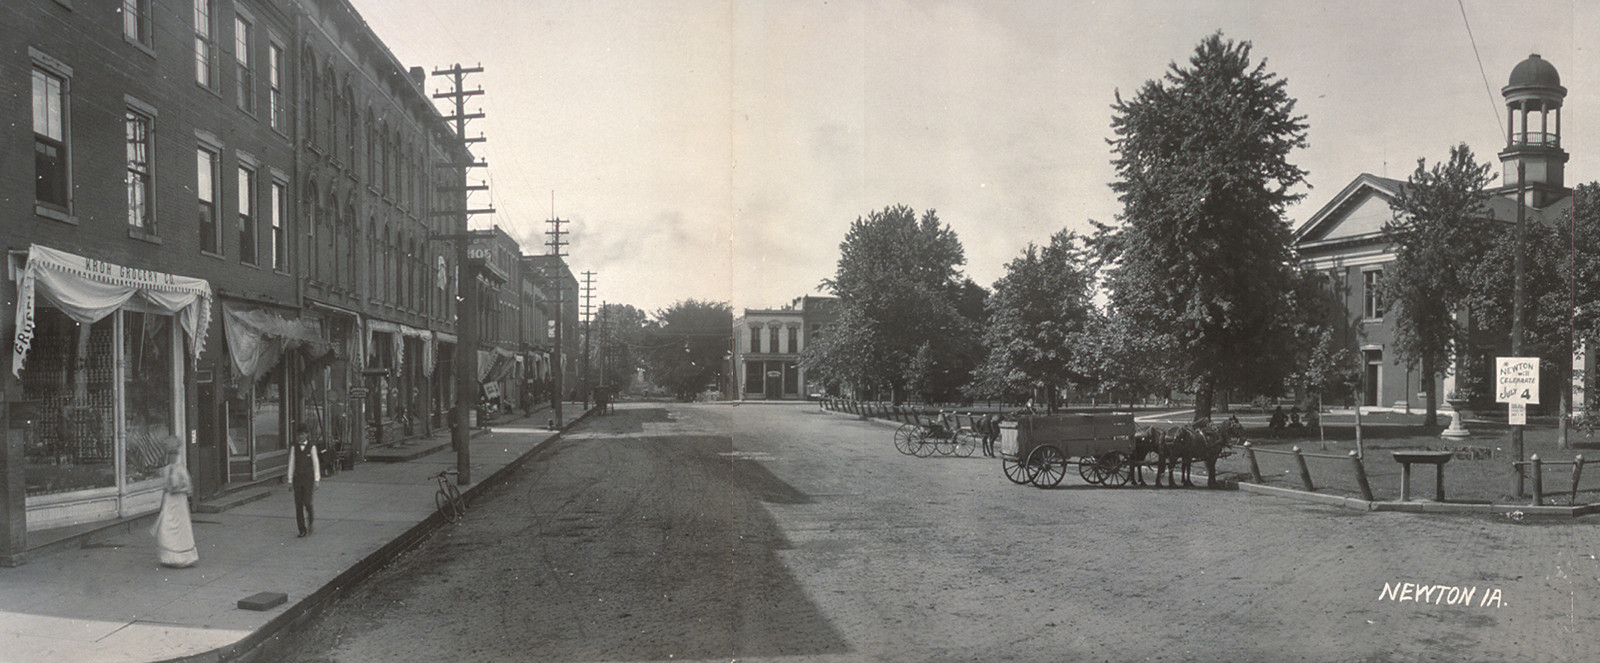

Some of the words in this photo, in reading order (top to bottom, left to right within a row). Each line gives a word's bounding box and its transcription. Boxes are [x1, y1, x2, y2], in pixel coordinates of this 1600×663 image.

[120, 265, 158, 283] GROCERY
[1500, 362, 1534, 376] NEWTON
[1500, 377, 1535, 385] CELEBRATE
[1520, 388, 1531, 400] 4
